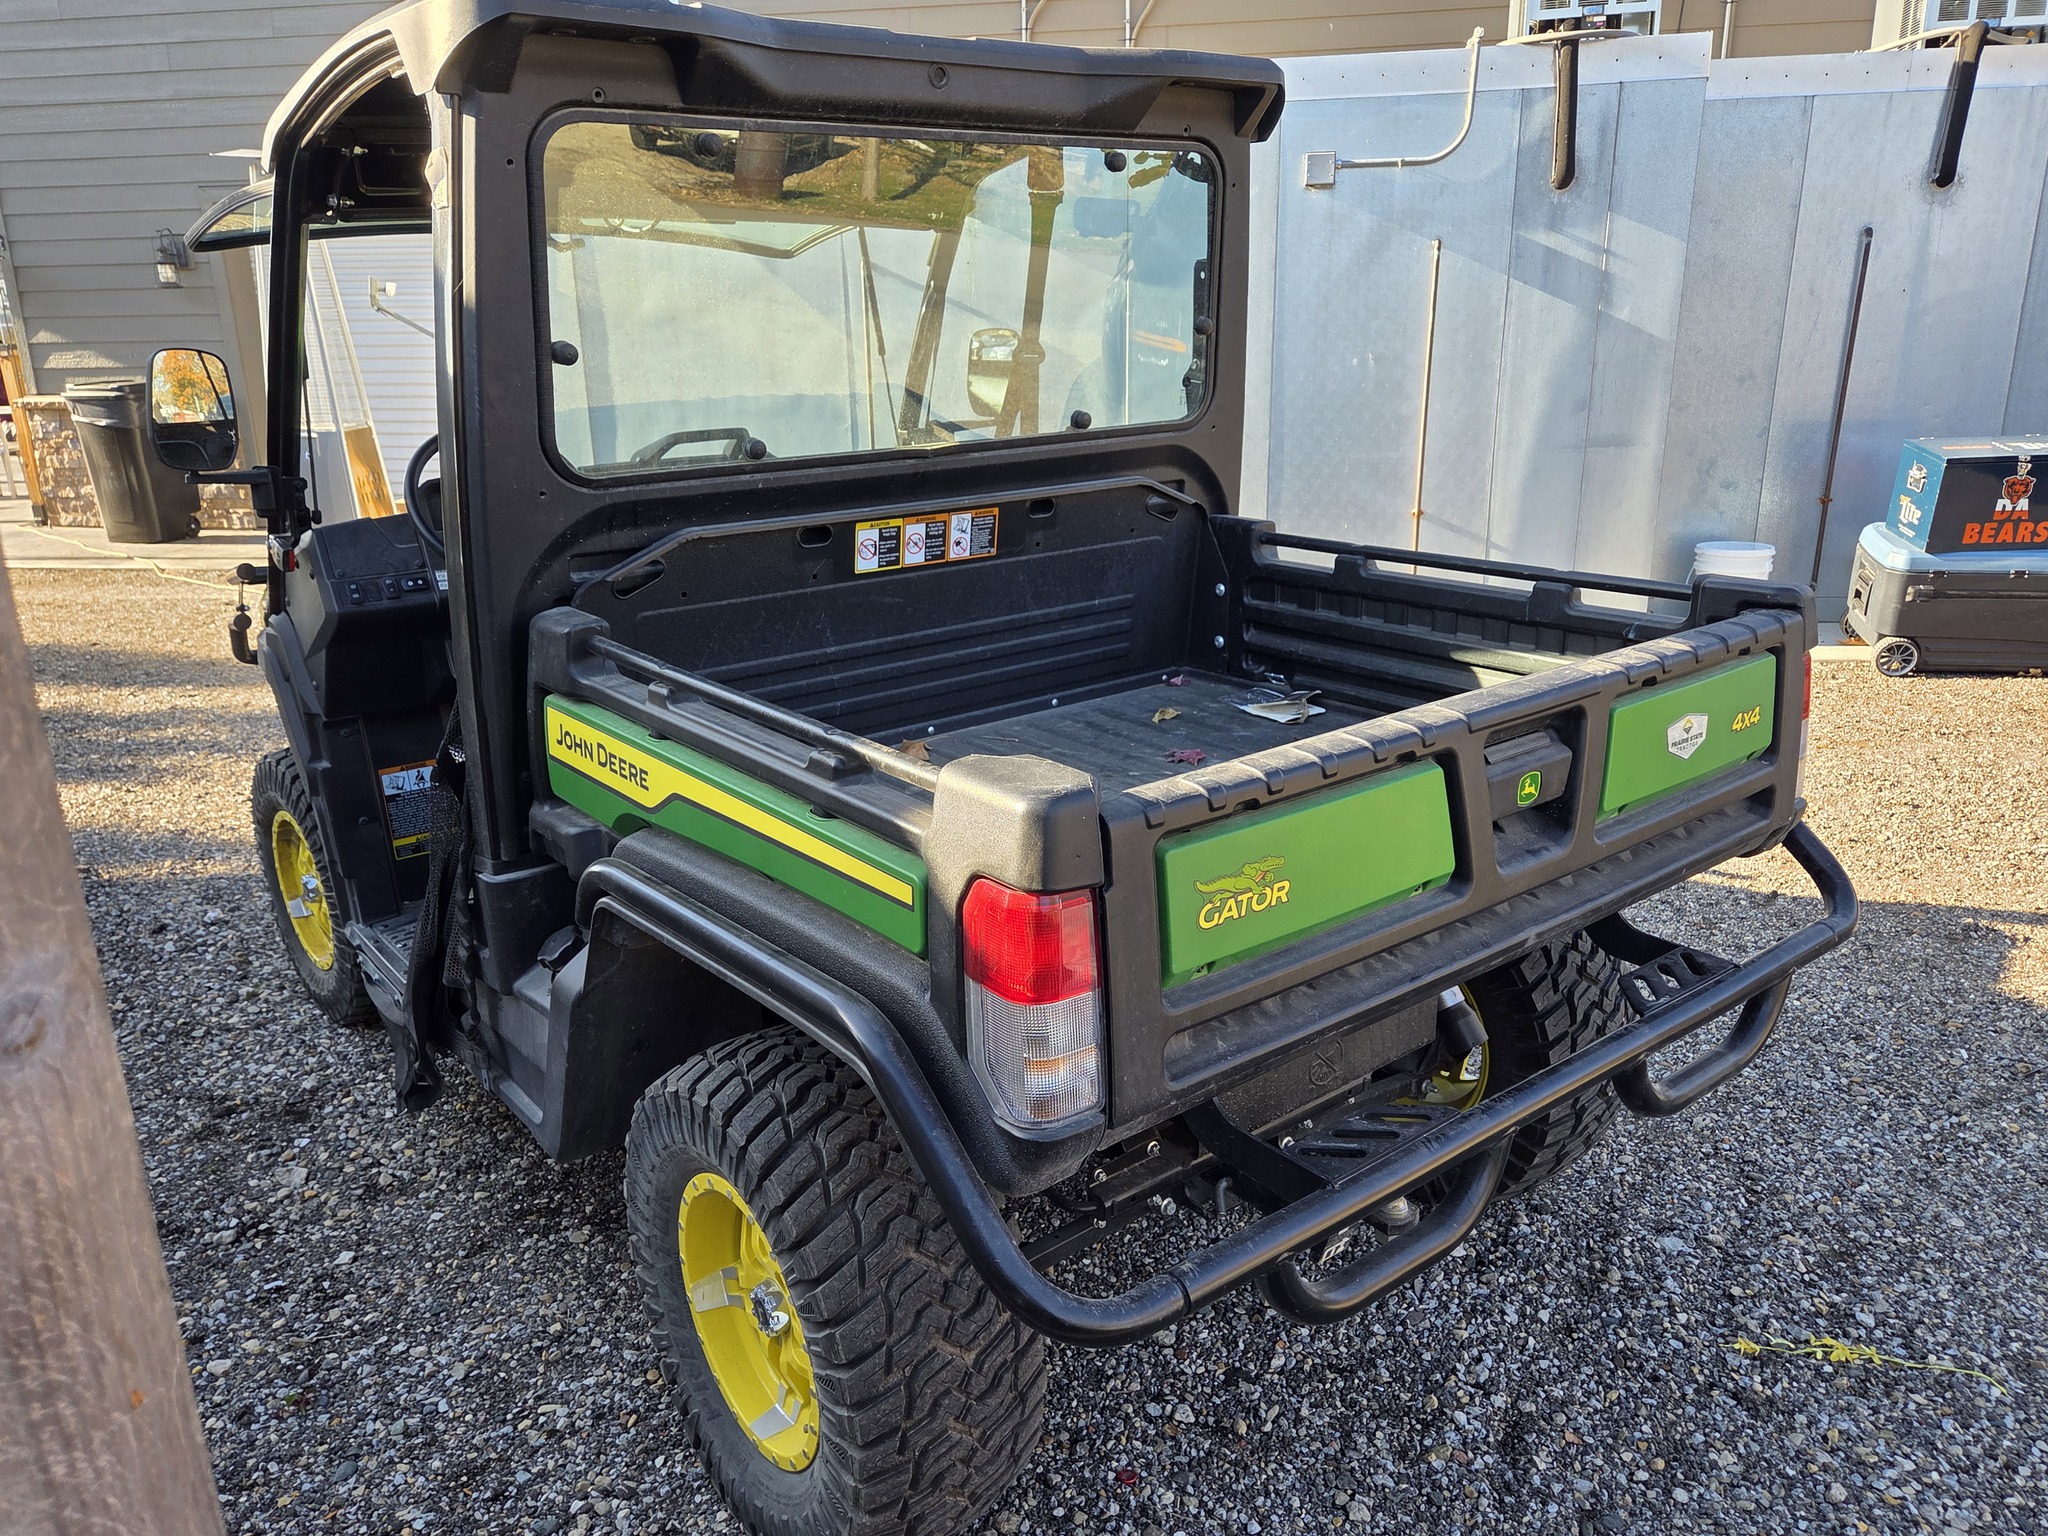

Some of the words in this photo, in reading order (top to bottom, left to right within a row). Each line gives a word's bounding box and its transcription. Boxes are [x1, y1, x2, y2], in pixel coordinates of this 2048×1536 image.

[1993, 498, 2029, 520] DA
[1962, 521, 2048, 544] BEARS
[556, 723, 594, 763] JOHN
[596, 741, 649, 791] DEERE
[1198, 879, 1292, 931] GATOR
